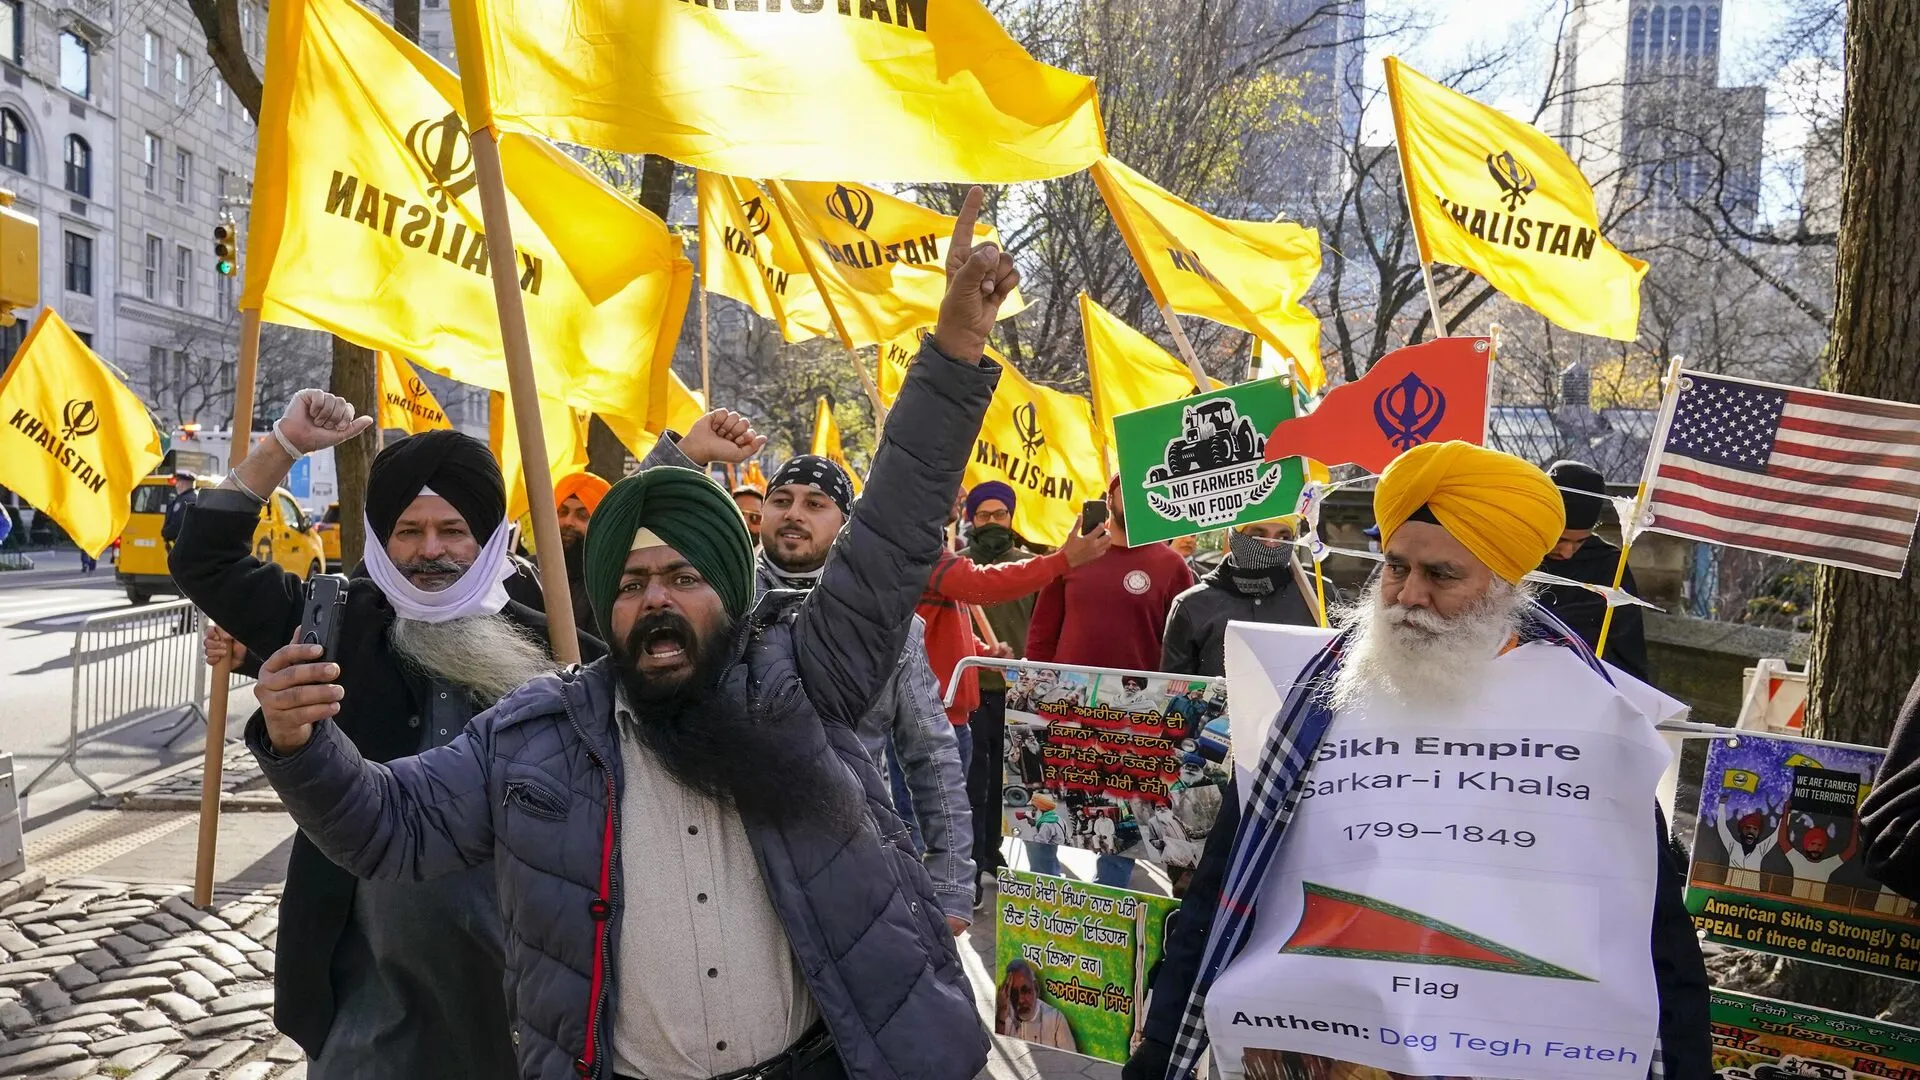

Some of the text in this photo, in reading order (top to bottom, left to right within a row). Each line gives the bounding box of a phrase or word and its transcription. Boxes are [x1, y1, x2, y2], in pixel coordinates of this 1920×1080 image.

[387, 393, 443, 423] KHALISTAN
[9, 408, 107, 494] KHALISTAN
[1172, 469, 1254, 499] NO FARMERS
[1188, 494, 1243, 518] NO FOOD
[1073, 703, 1126, 721] ਅਮਰੀਕਾ
[1130, 711, 1161, 726] ਵਾਲੇ
[1166, 712, 1185, 730] ਵੀ
[1048, 721, 1094, 740] ਕਿਸਾਨਾਂ
[1099, 731, 1129, 745] ਨਾਲ
[1317, 736, 1582, 761] Sikh Empire
[1045, 766, 1058, 780] ਕੇ
[1063, 767, 1101, 786] ਦਿੱਲੀ
[1164, 756, 1177, 774] ਹੋ
[1458, 771, 1591, 801] Khalsa
[1794, 787, 1856, 805] NOT TERRORISTS
[1796, 775, 1858, 792] WE ARE FARMERS
[1343, 821, 1537, 848] 1799–1849
[1035, 877, 1057, 903] ਮੋਦੀ
[1090, 896, 1113, 912] ਨਾਲ
[1004, 904, 1025, 925] ਲੈਣ
[1044, 911, 1079, 935] ਪਹਿਲਾਂ
[1083, 917, 1128, 947] ਇਤਿਹਾਸ
[1704, 897, 1777, 924] American
[1780, 911, 1823, 933] Sikhs
[1827, 919, 1896, 948] Strongly
[1045, 942, 1076, 966] ਲਿਆ
[1690, 915, 1742, 939] EPEAL
[1747, 926, 1763, 942] of
[1766, 929, 1806, 950] three
[1810, 938, 1890, 967] draconian
[1047, 978, 1132, 1013] ਅਮਰੀਕਨ ਸਿੱਖ
[1392, 975, 1460, 999] Flag
[1231, 1010, 1638, 1065] Anthem: Deg Tegh Fateh
